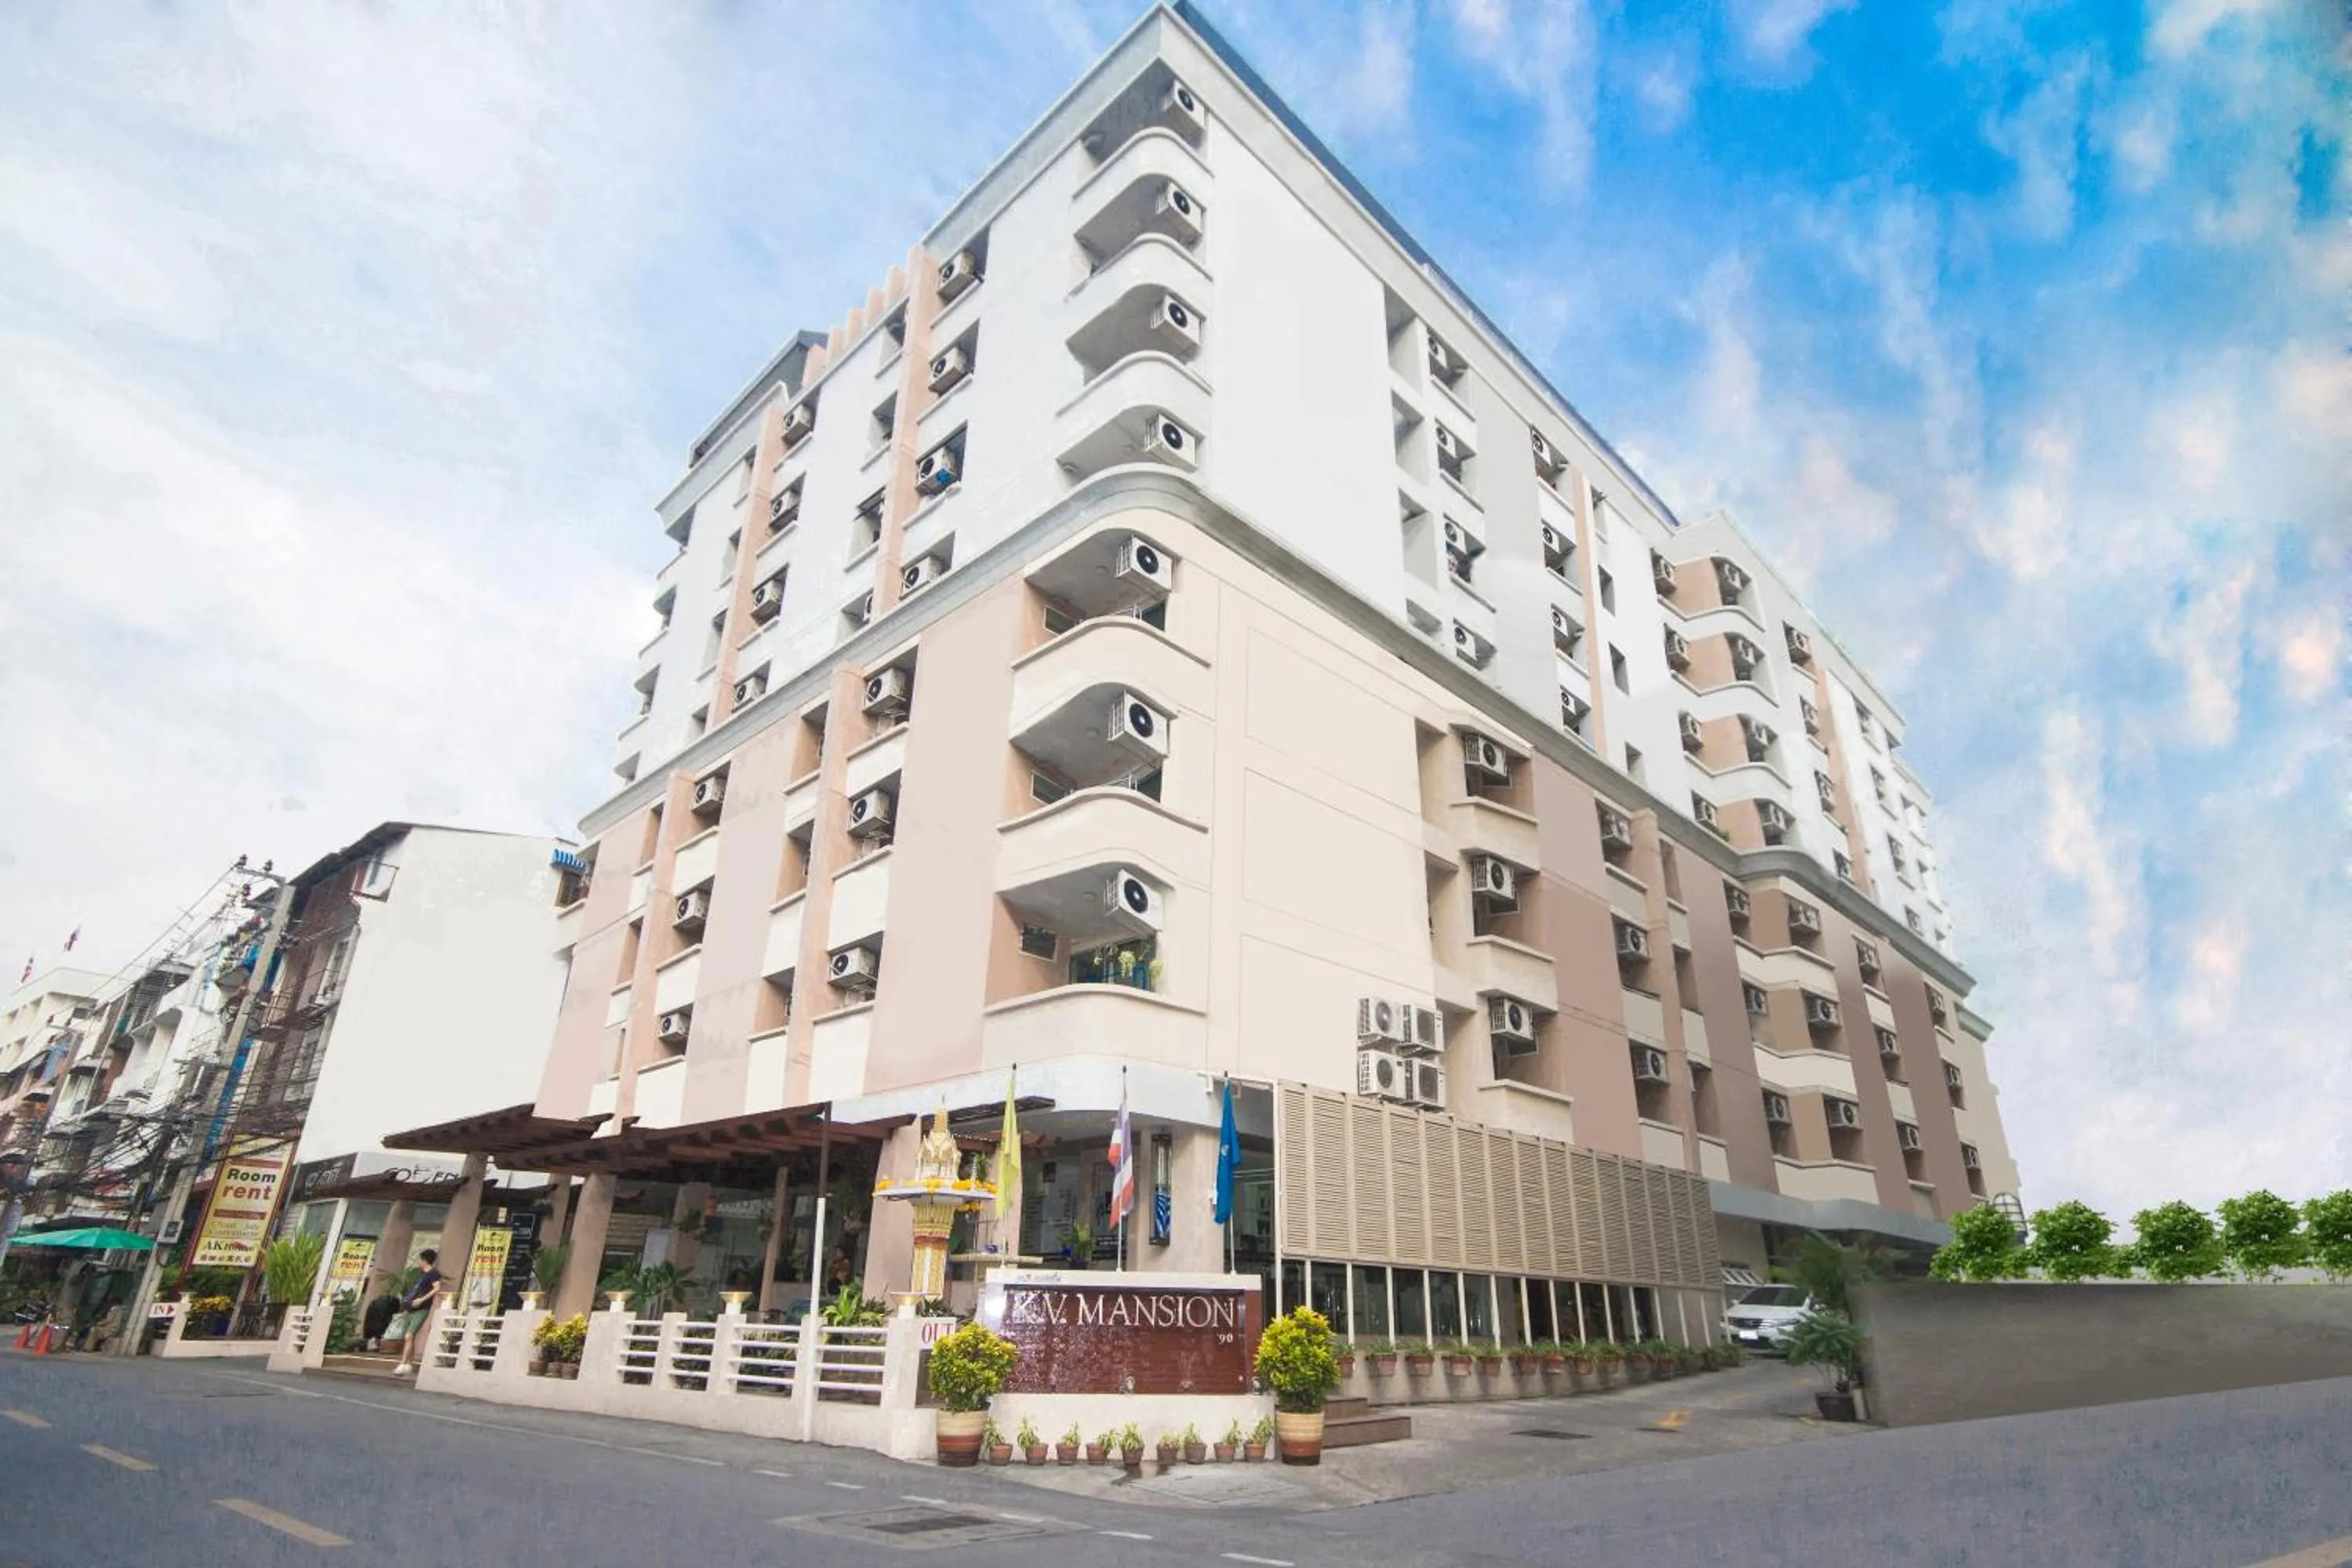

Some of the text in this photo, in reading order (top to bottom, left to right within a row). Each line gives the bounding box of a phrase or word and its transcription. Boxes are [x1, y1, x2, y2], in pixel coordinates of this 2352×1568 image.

[227, 1168, 277, 1183] Room
[223, 1185, 271, 1200] rent
[1076, 1294, 1235, 1327] MANSION
[921, 1323, 954, 1343] OUT
